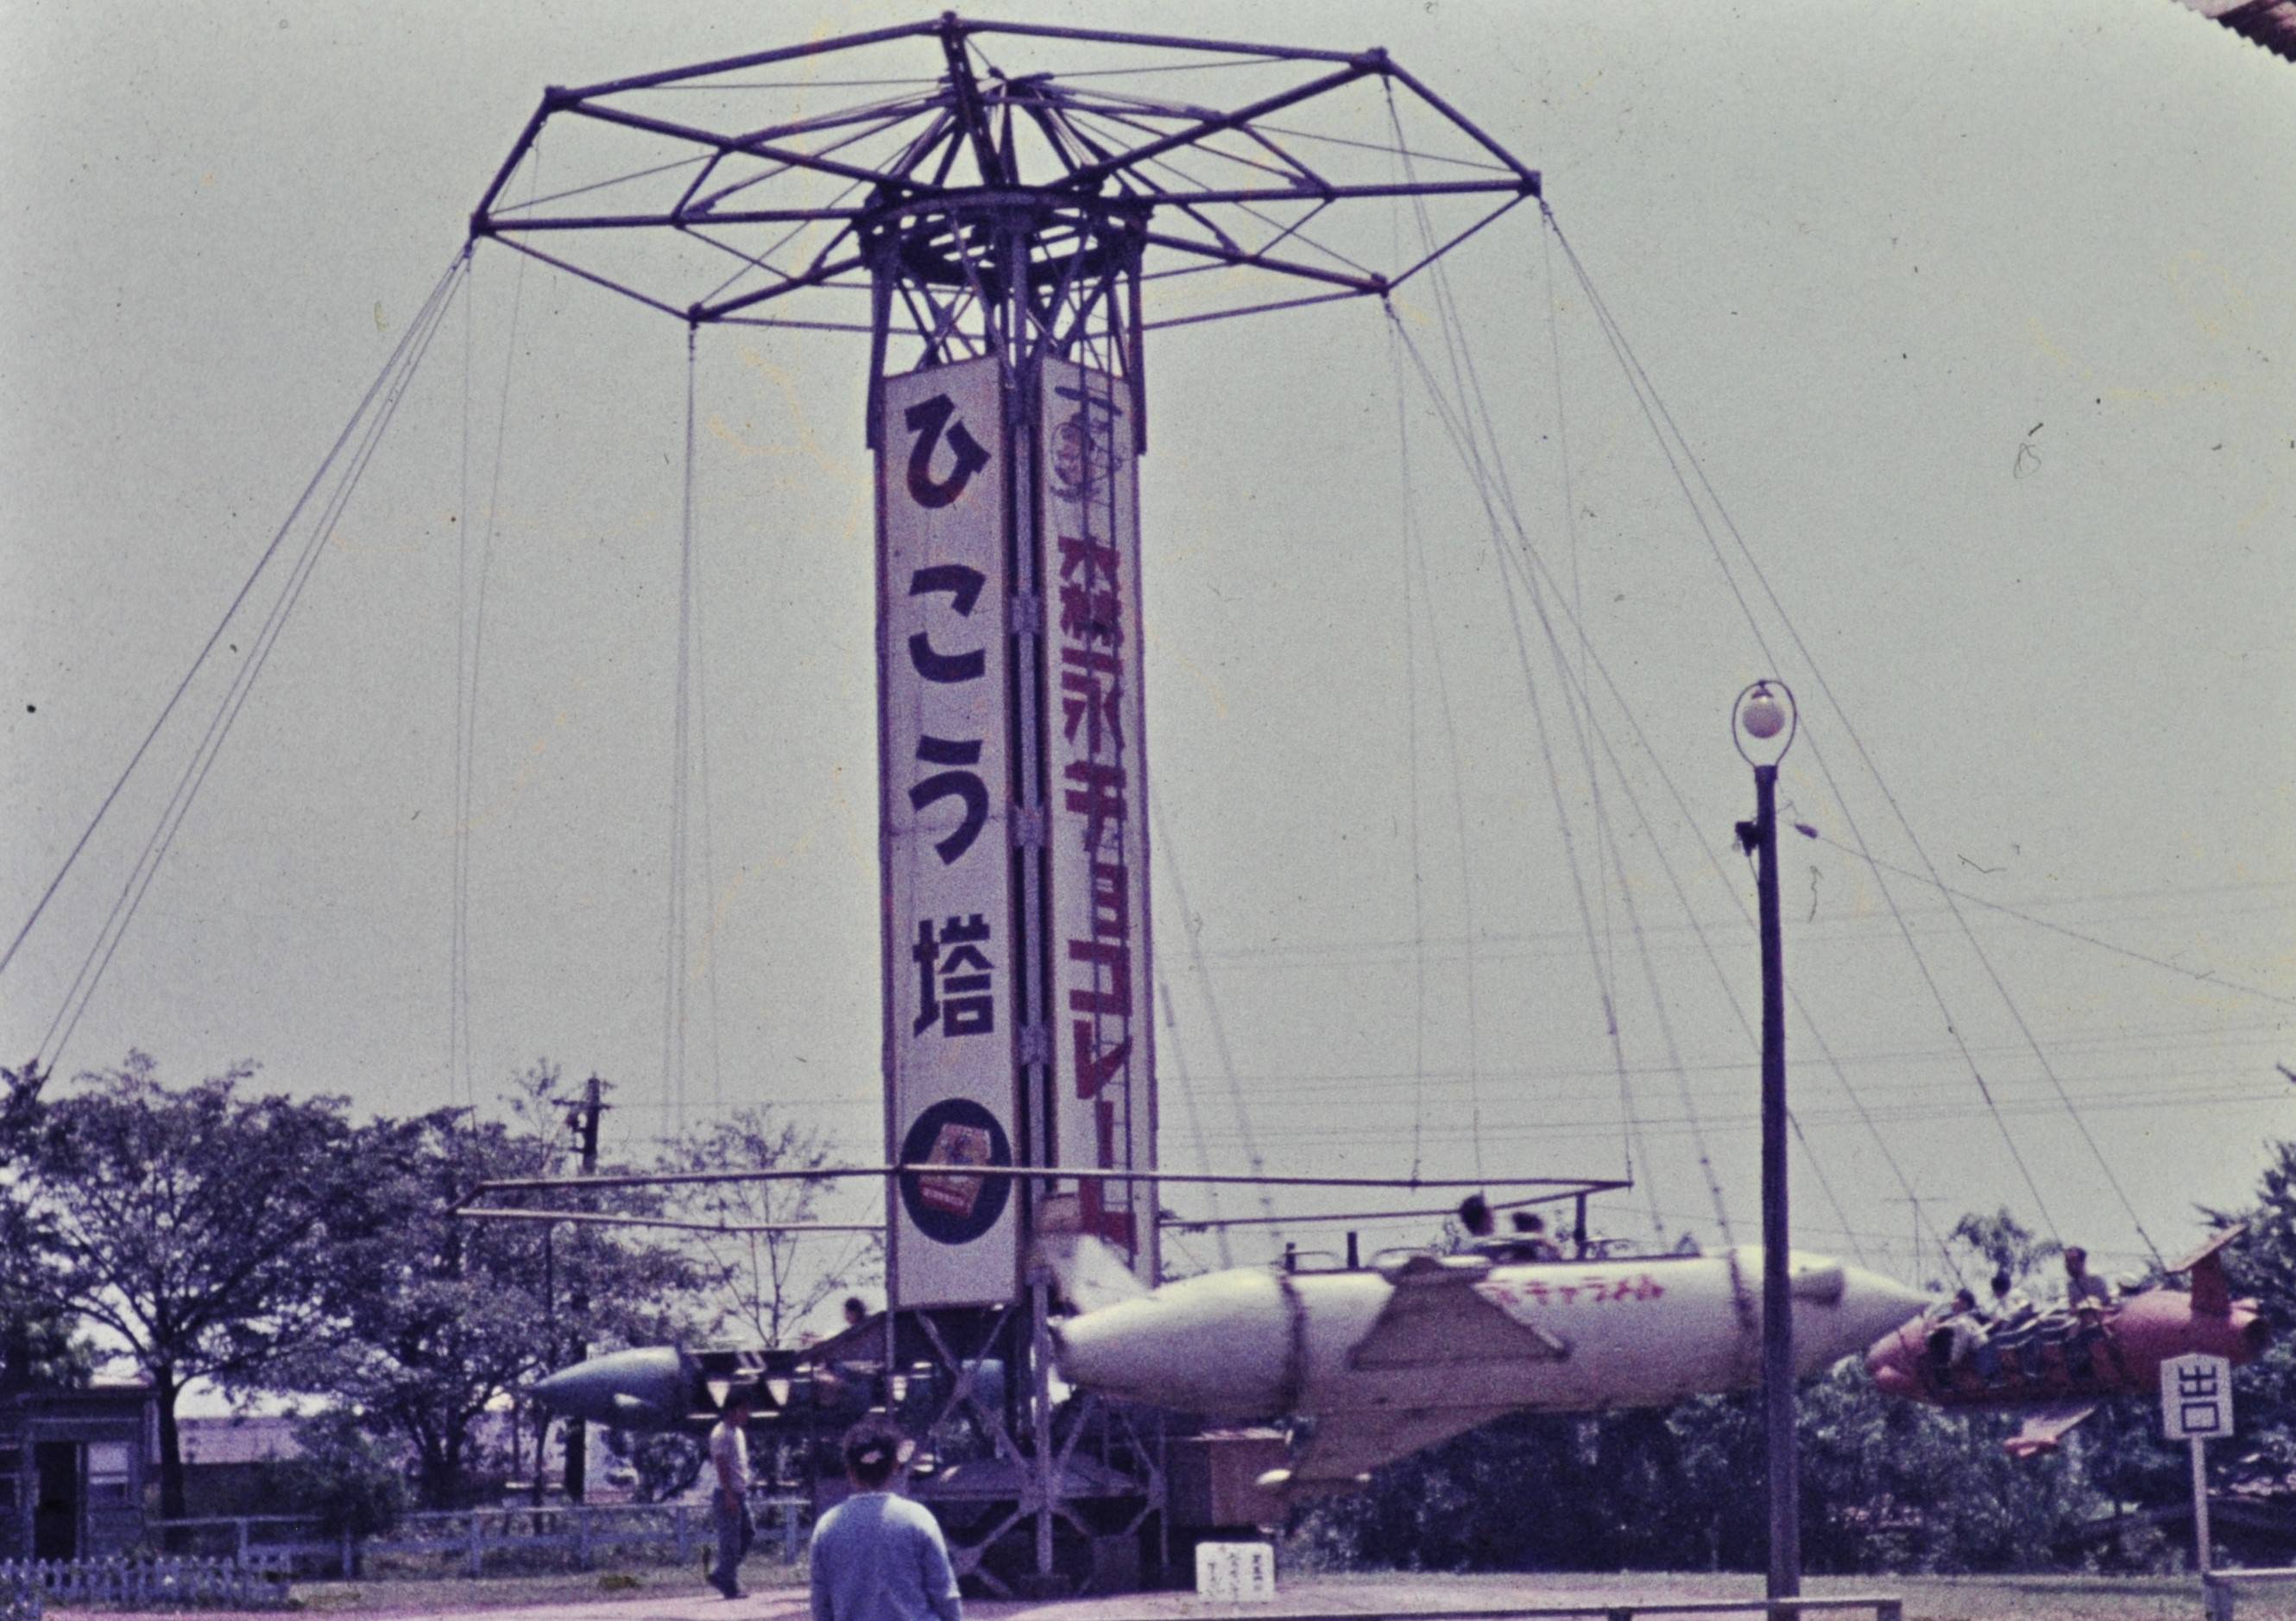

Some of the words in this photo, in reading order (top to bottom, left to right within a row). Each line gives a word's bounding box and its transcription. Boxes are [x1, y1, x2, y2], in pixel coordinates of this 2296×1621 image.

[905, 394, 994, 1038] ひこう塔
[1057, 534, 1138, 1255] 森永チョコレート
[2178, 1365, 2220, 1432] 出口
